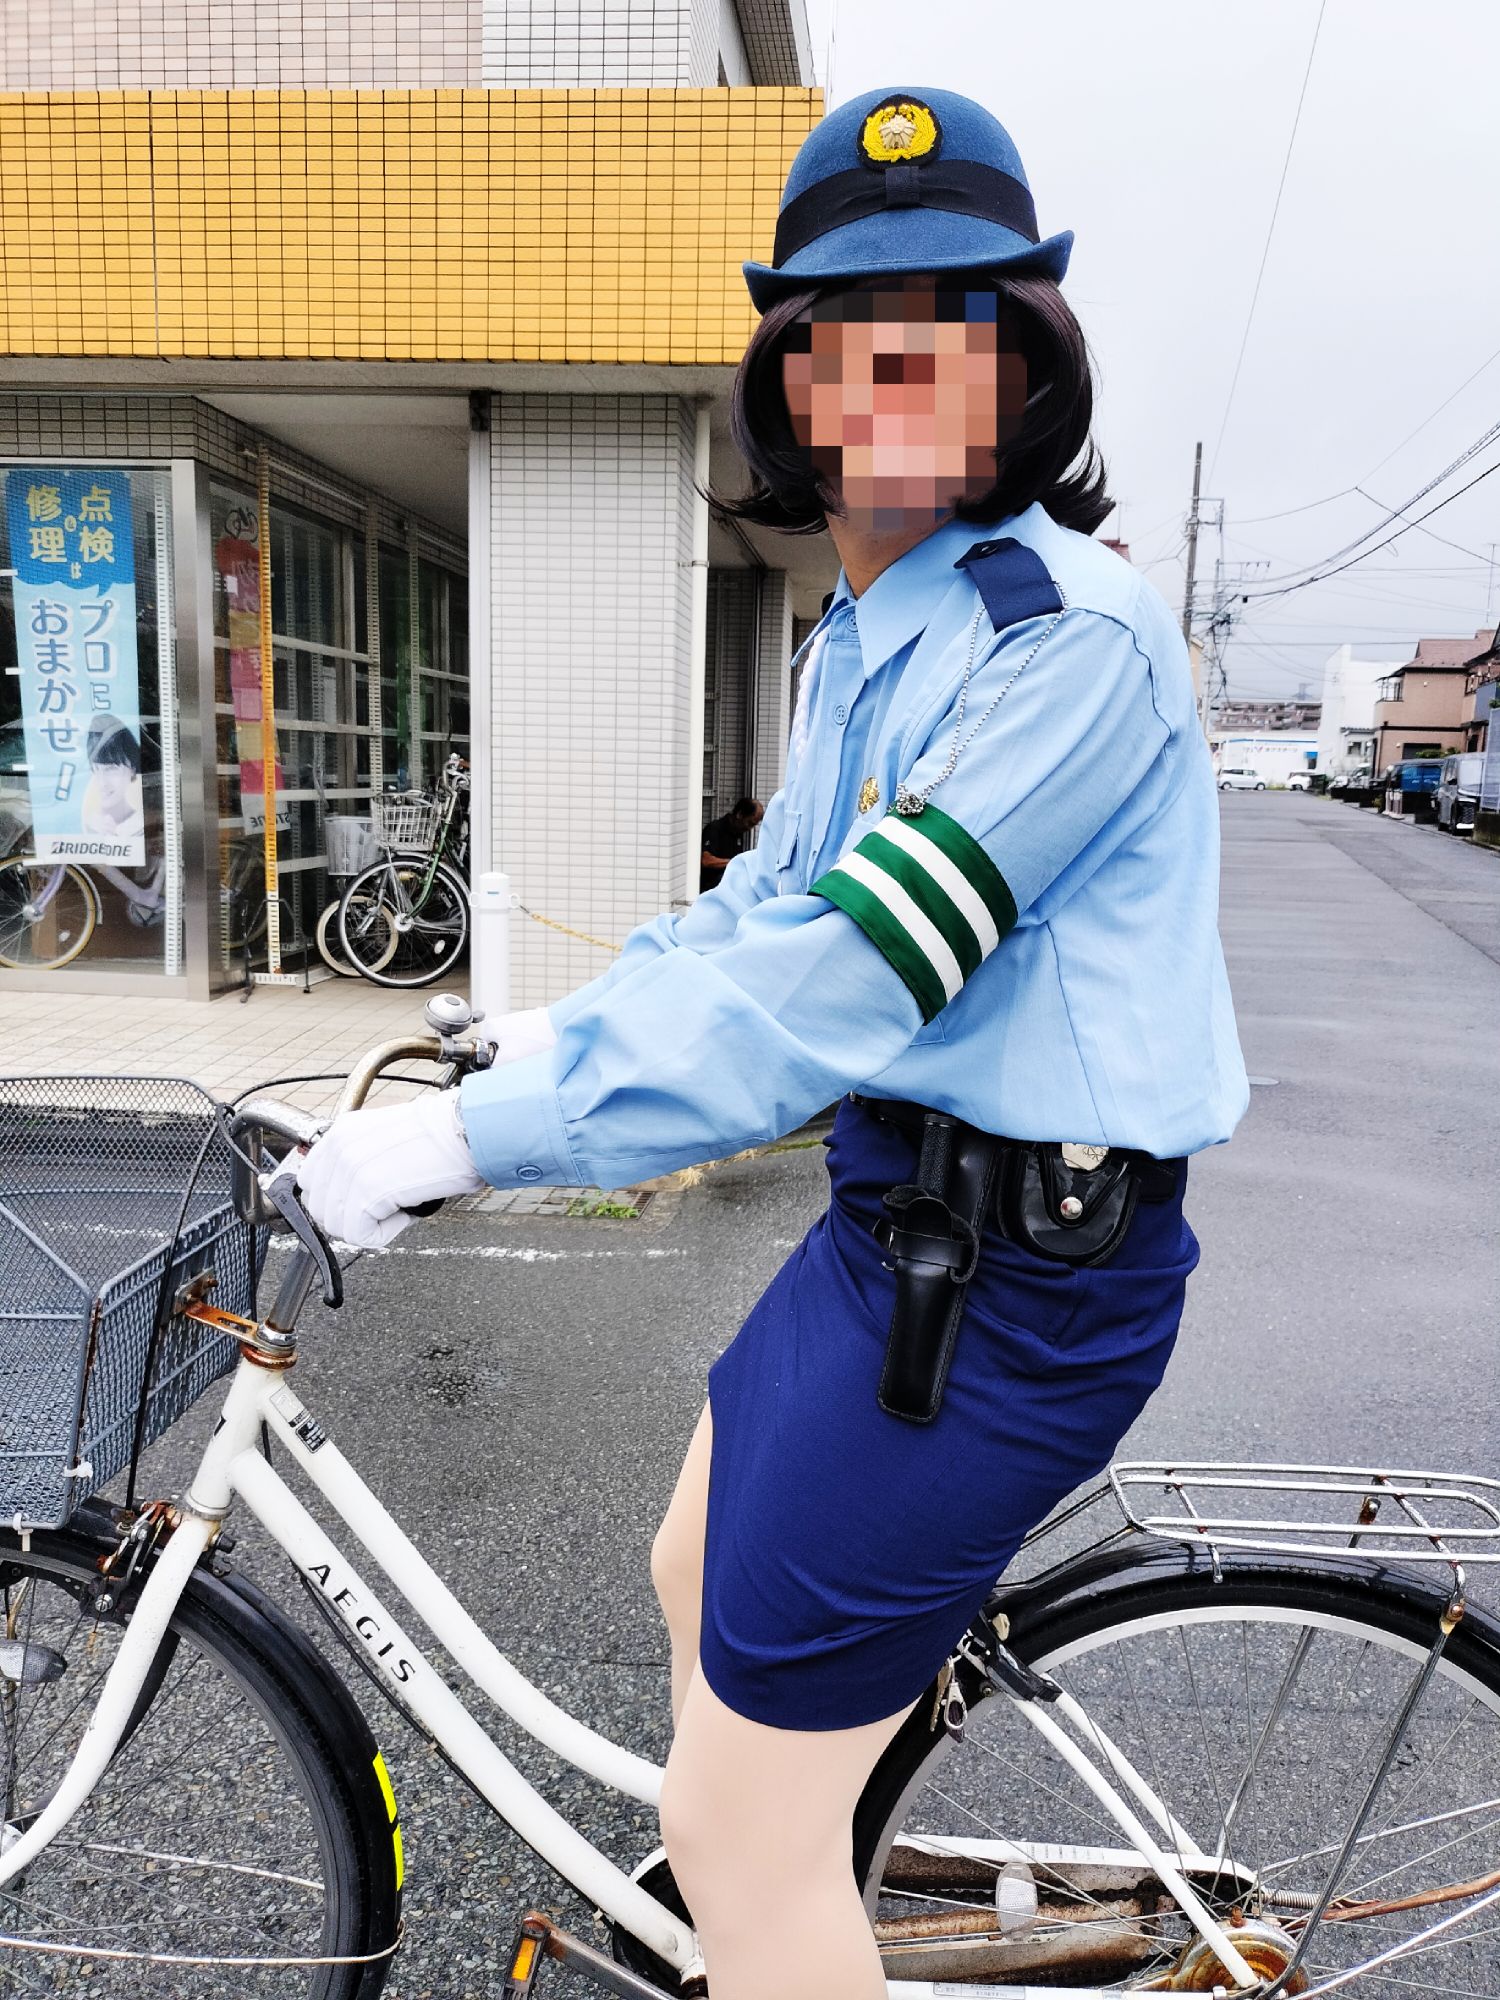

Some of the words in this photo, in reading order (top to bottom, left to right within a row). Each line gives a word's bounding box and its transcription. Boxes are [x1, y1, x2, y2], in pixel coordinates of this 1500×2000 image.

[25, 484, 67, 563] 修理
[78, 483, 115, 563] 点検
[80, 600, 114, 712] プロに
[308, 1564, 416, 1682] AEGIS
